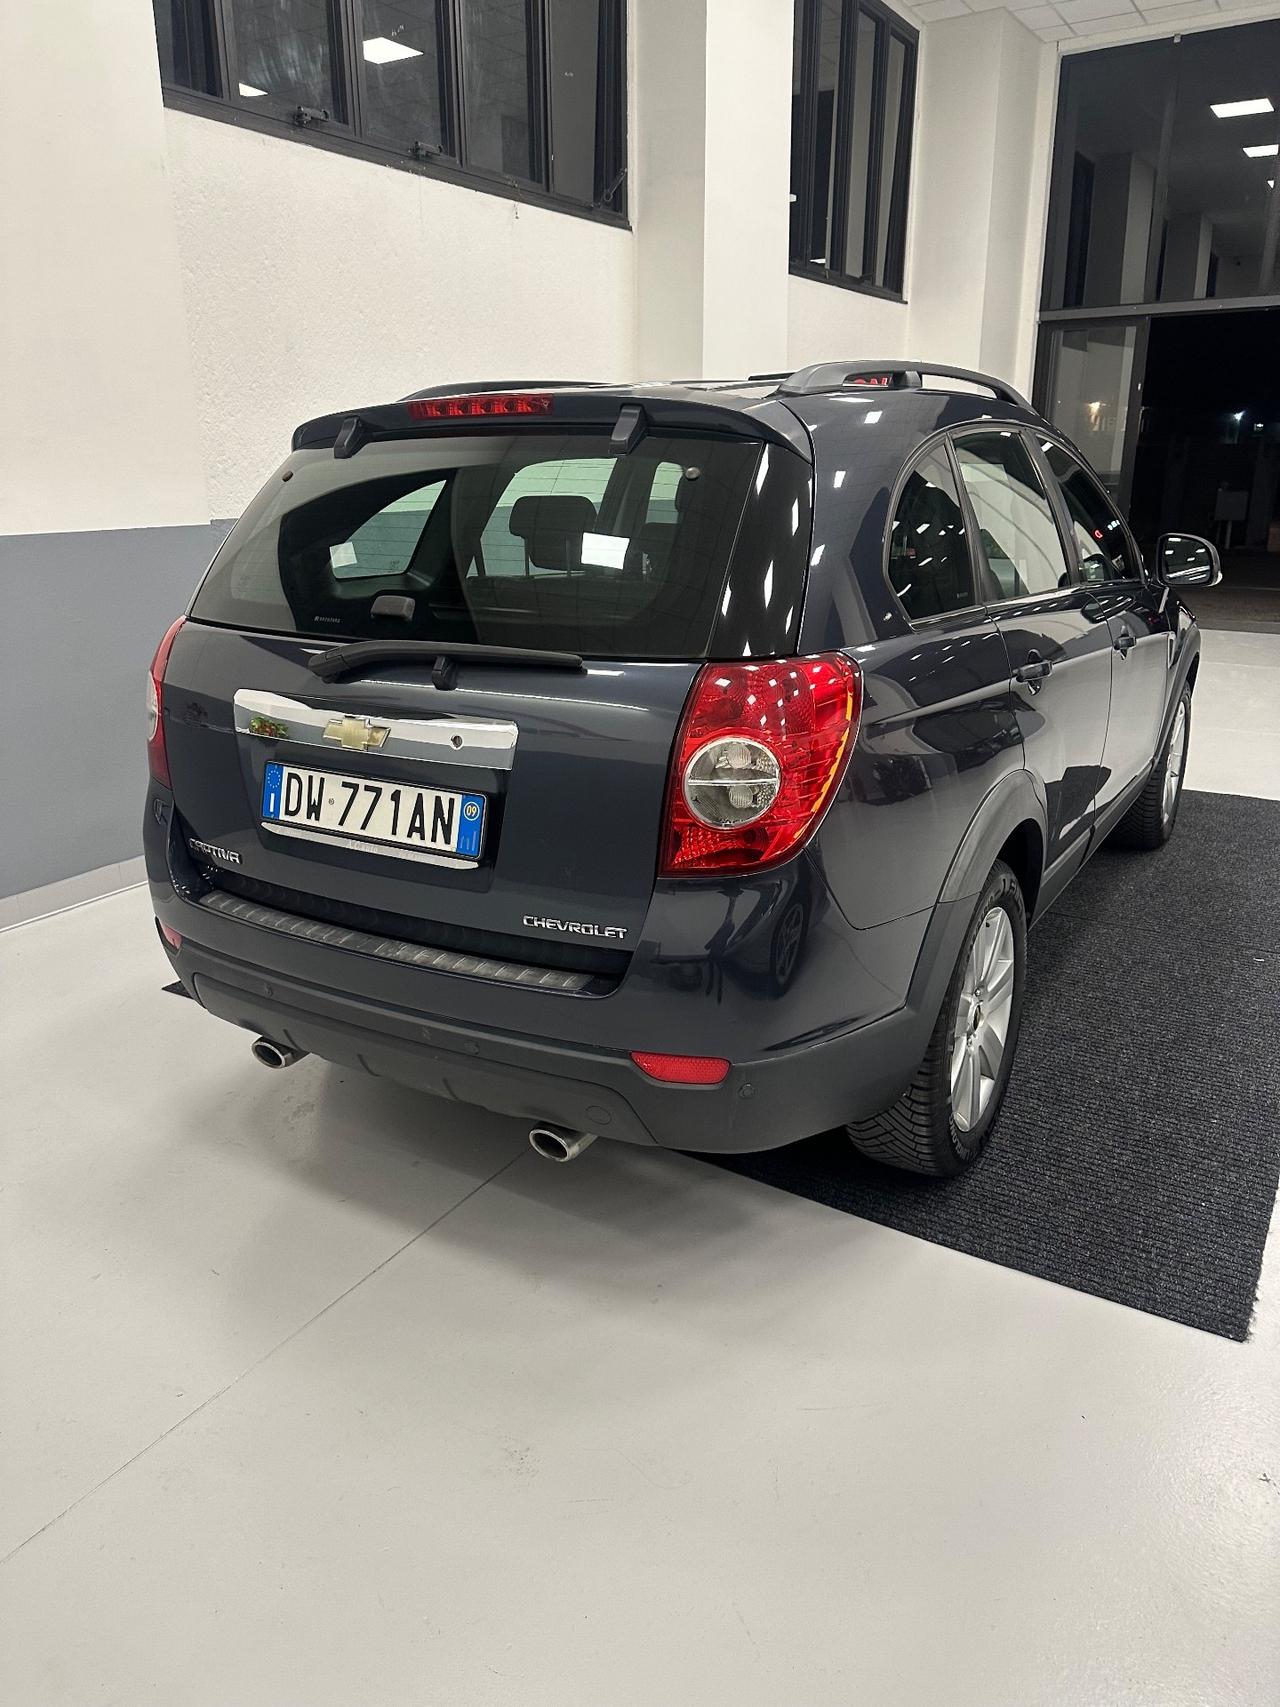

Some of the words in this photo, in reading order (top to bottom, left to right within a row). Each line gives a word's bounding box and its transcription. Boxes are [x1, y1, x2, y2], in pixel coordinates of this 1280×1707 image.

[284, 772, 325, 822] DW
[338, 780, 455, 845] 771AN
[466, 804, 477, 816] 09
[522, 915, 628, 940] CHEVROLET
